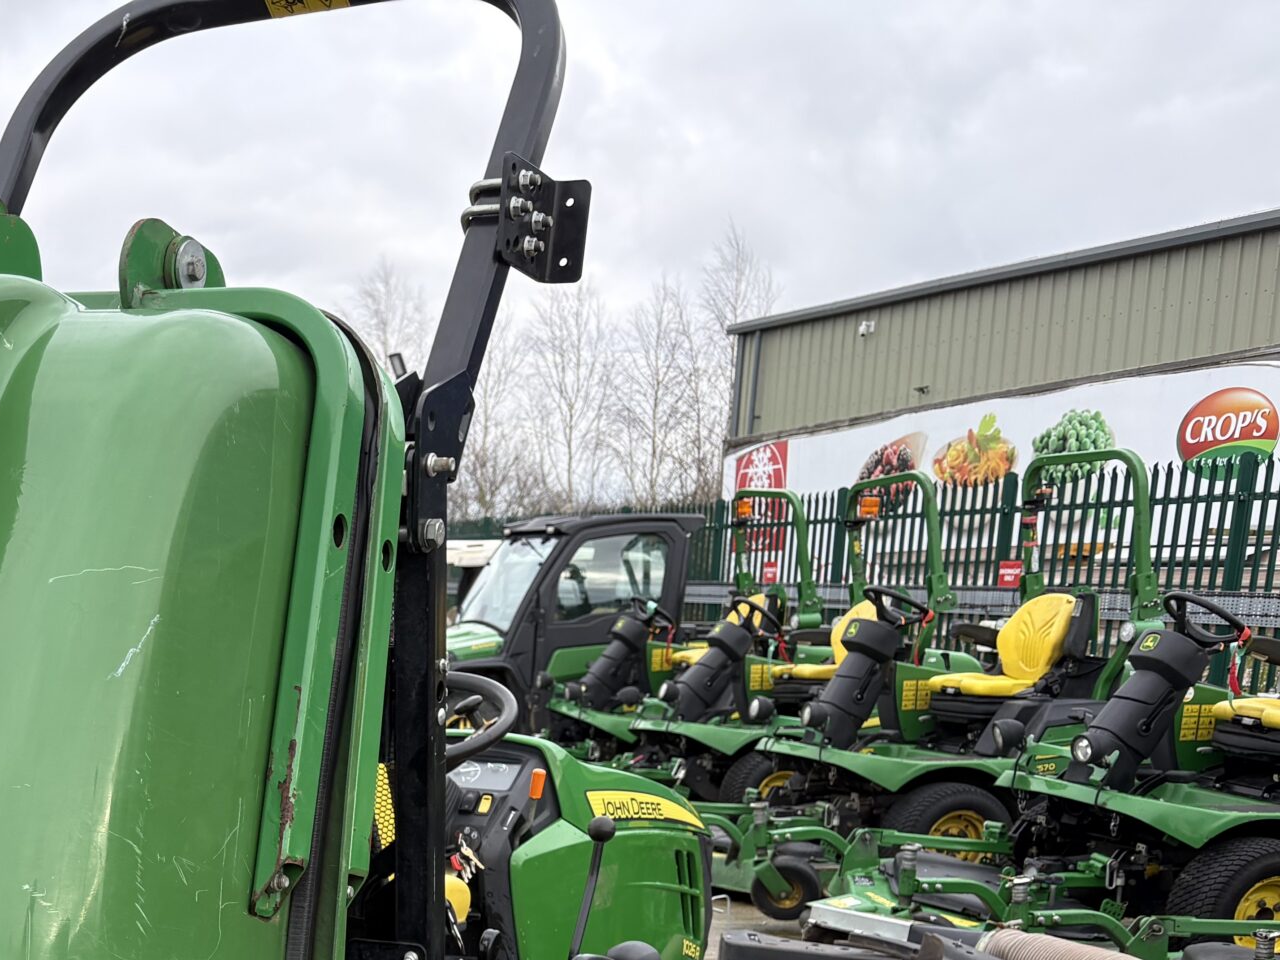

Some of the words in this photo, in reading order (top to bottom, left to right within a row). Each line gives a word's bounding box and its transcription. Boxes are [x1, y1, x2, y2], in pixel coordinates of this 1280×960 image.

[1185, 408, 1270, 444] CROP'S
[601, 798, 631, 816] JOHN
[630, 798, 664, 817] DEERE
